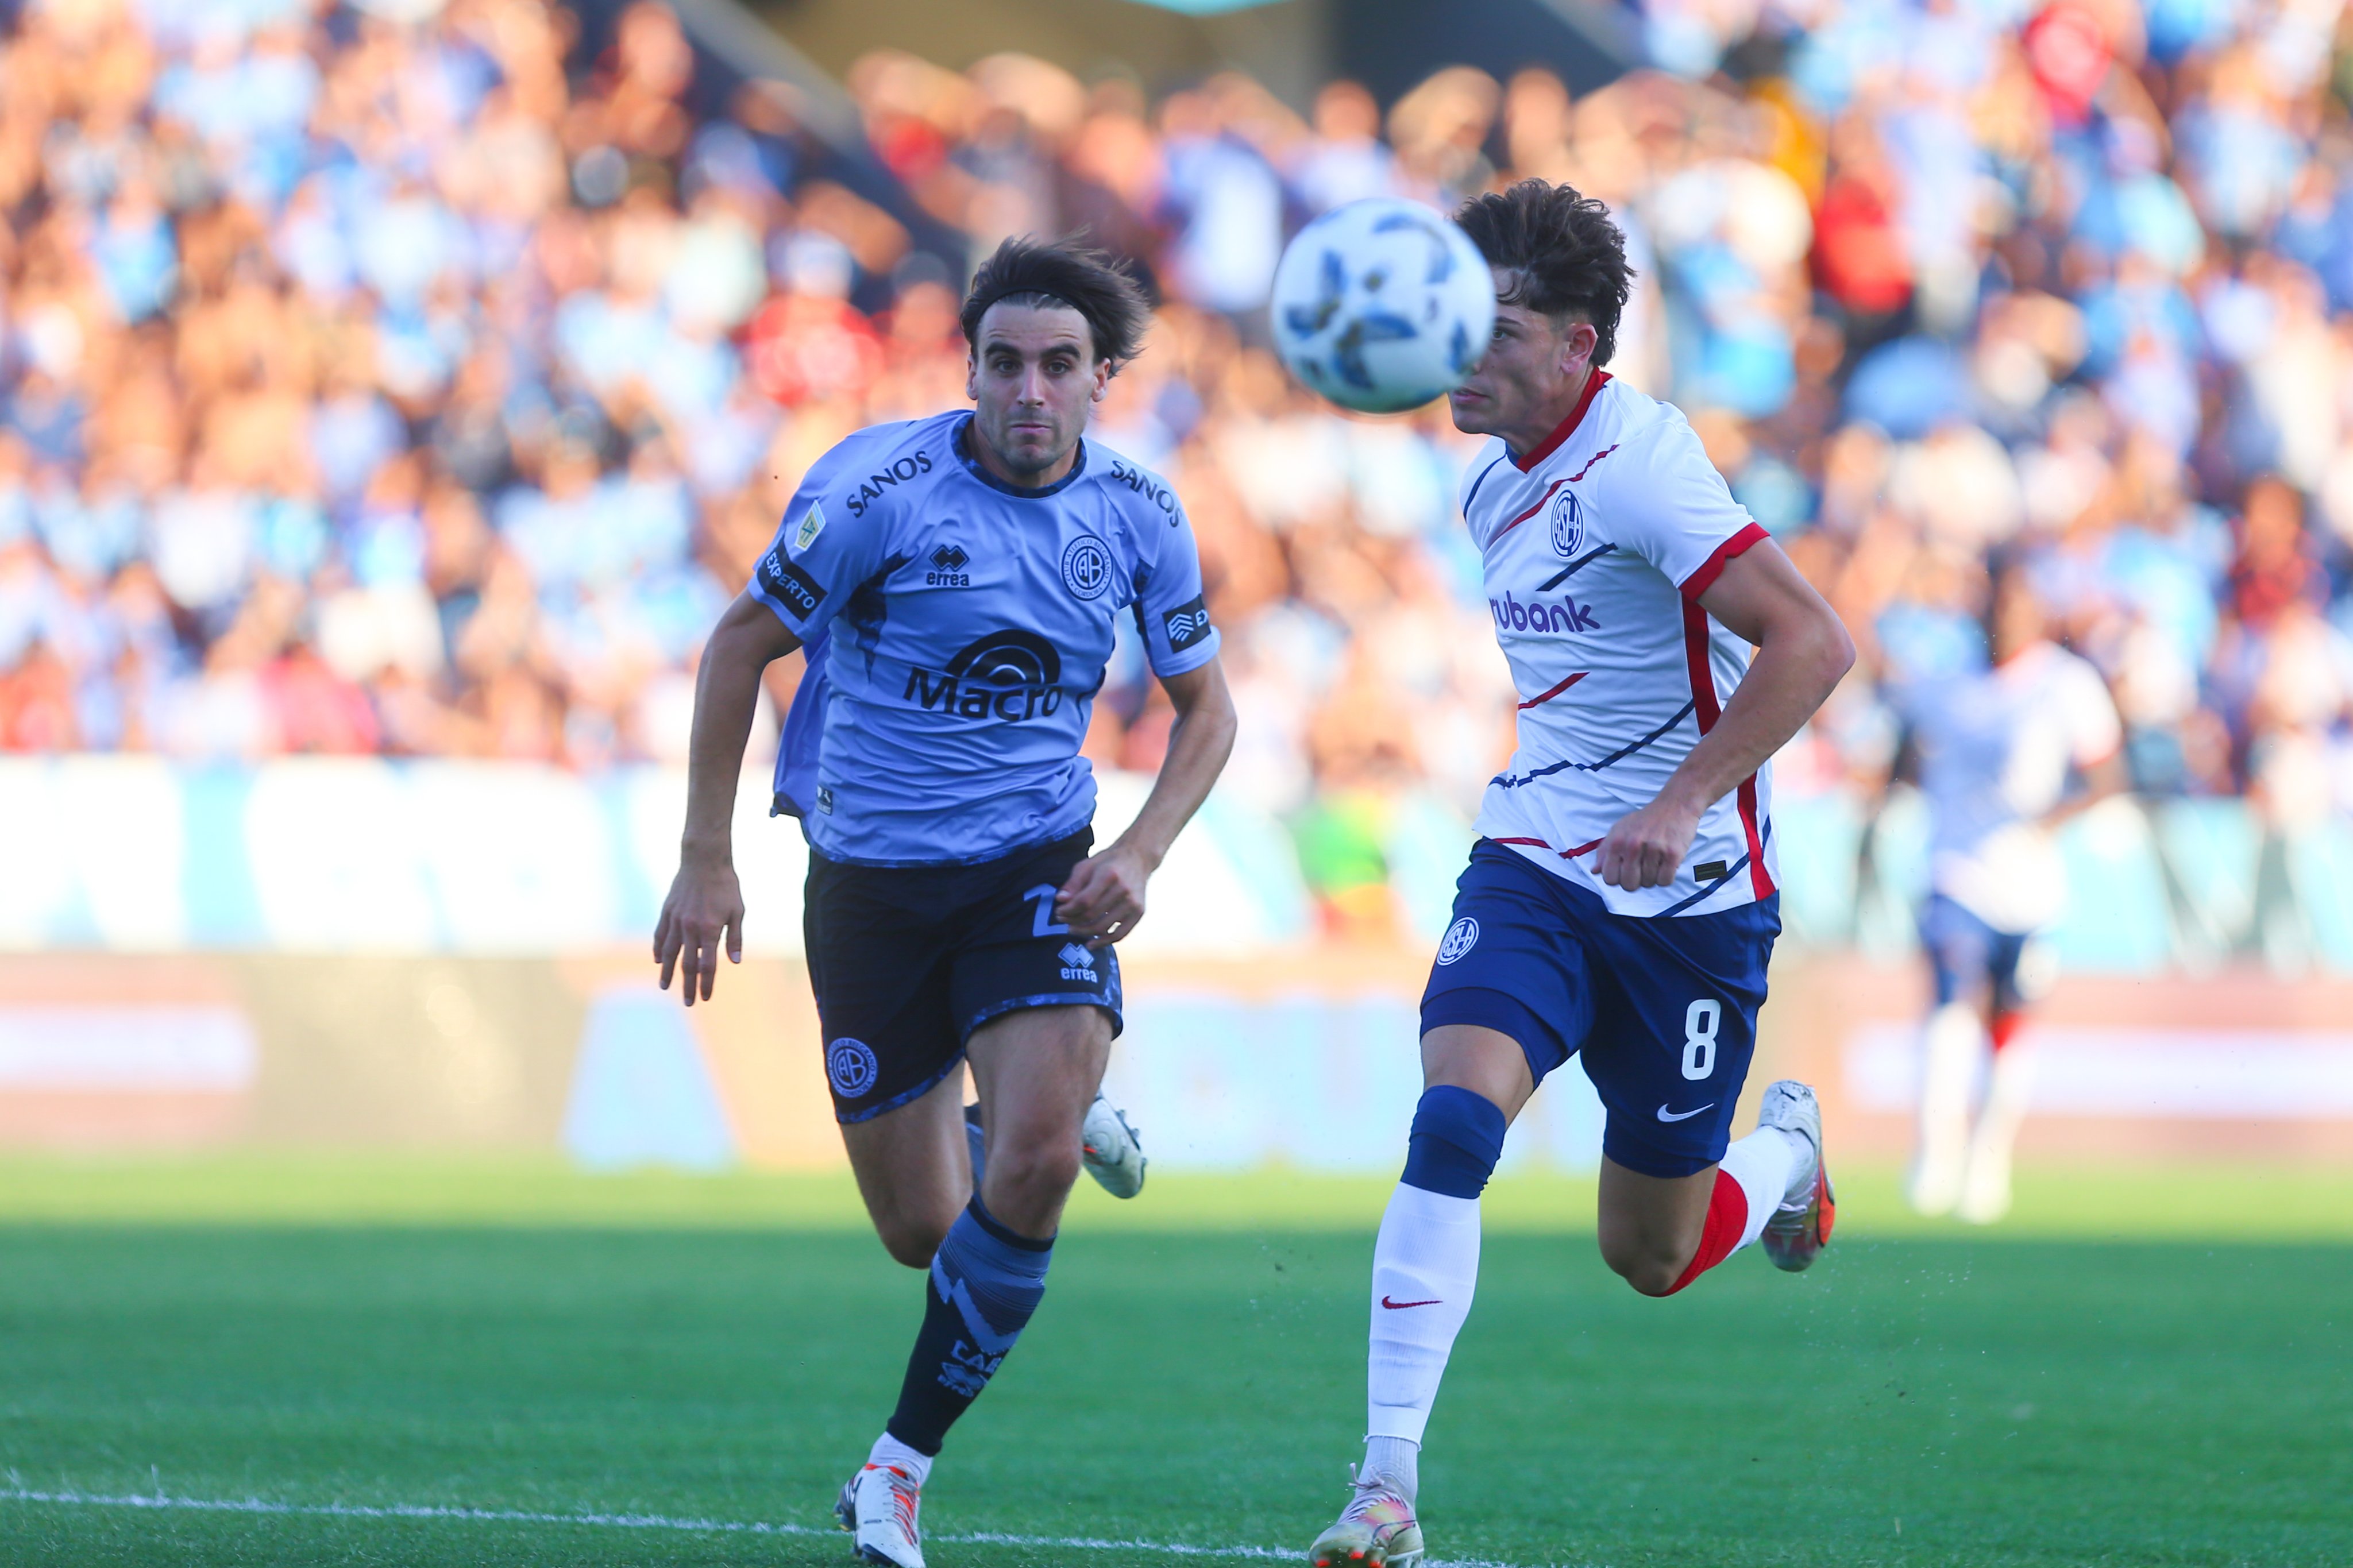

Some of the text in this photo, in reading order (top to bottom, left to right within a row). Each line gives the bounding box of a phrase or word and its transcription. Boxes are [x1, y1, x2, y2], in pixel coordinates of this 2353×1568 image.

[846, 450, 932, 519] SANOS
[1110, 460, 1182, 528] SANOS
[766, 551, 816, 609] EXPERTO
[926, 571, 969, 586] errea
[1063, 559, 1072, 581] CLUB
[1093, 540, 1110, 579] BELGRANO
[903, 667, 1062, 722] Macro
[1060, 967, 1098, 984] errea
[1681, 999, 1721, 1080] 8
